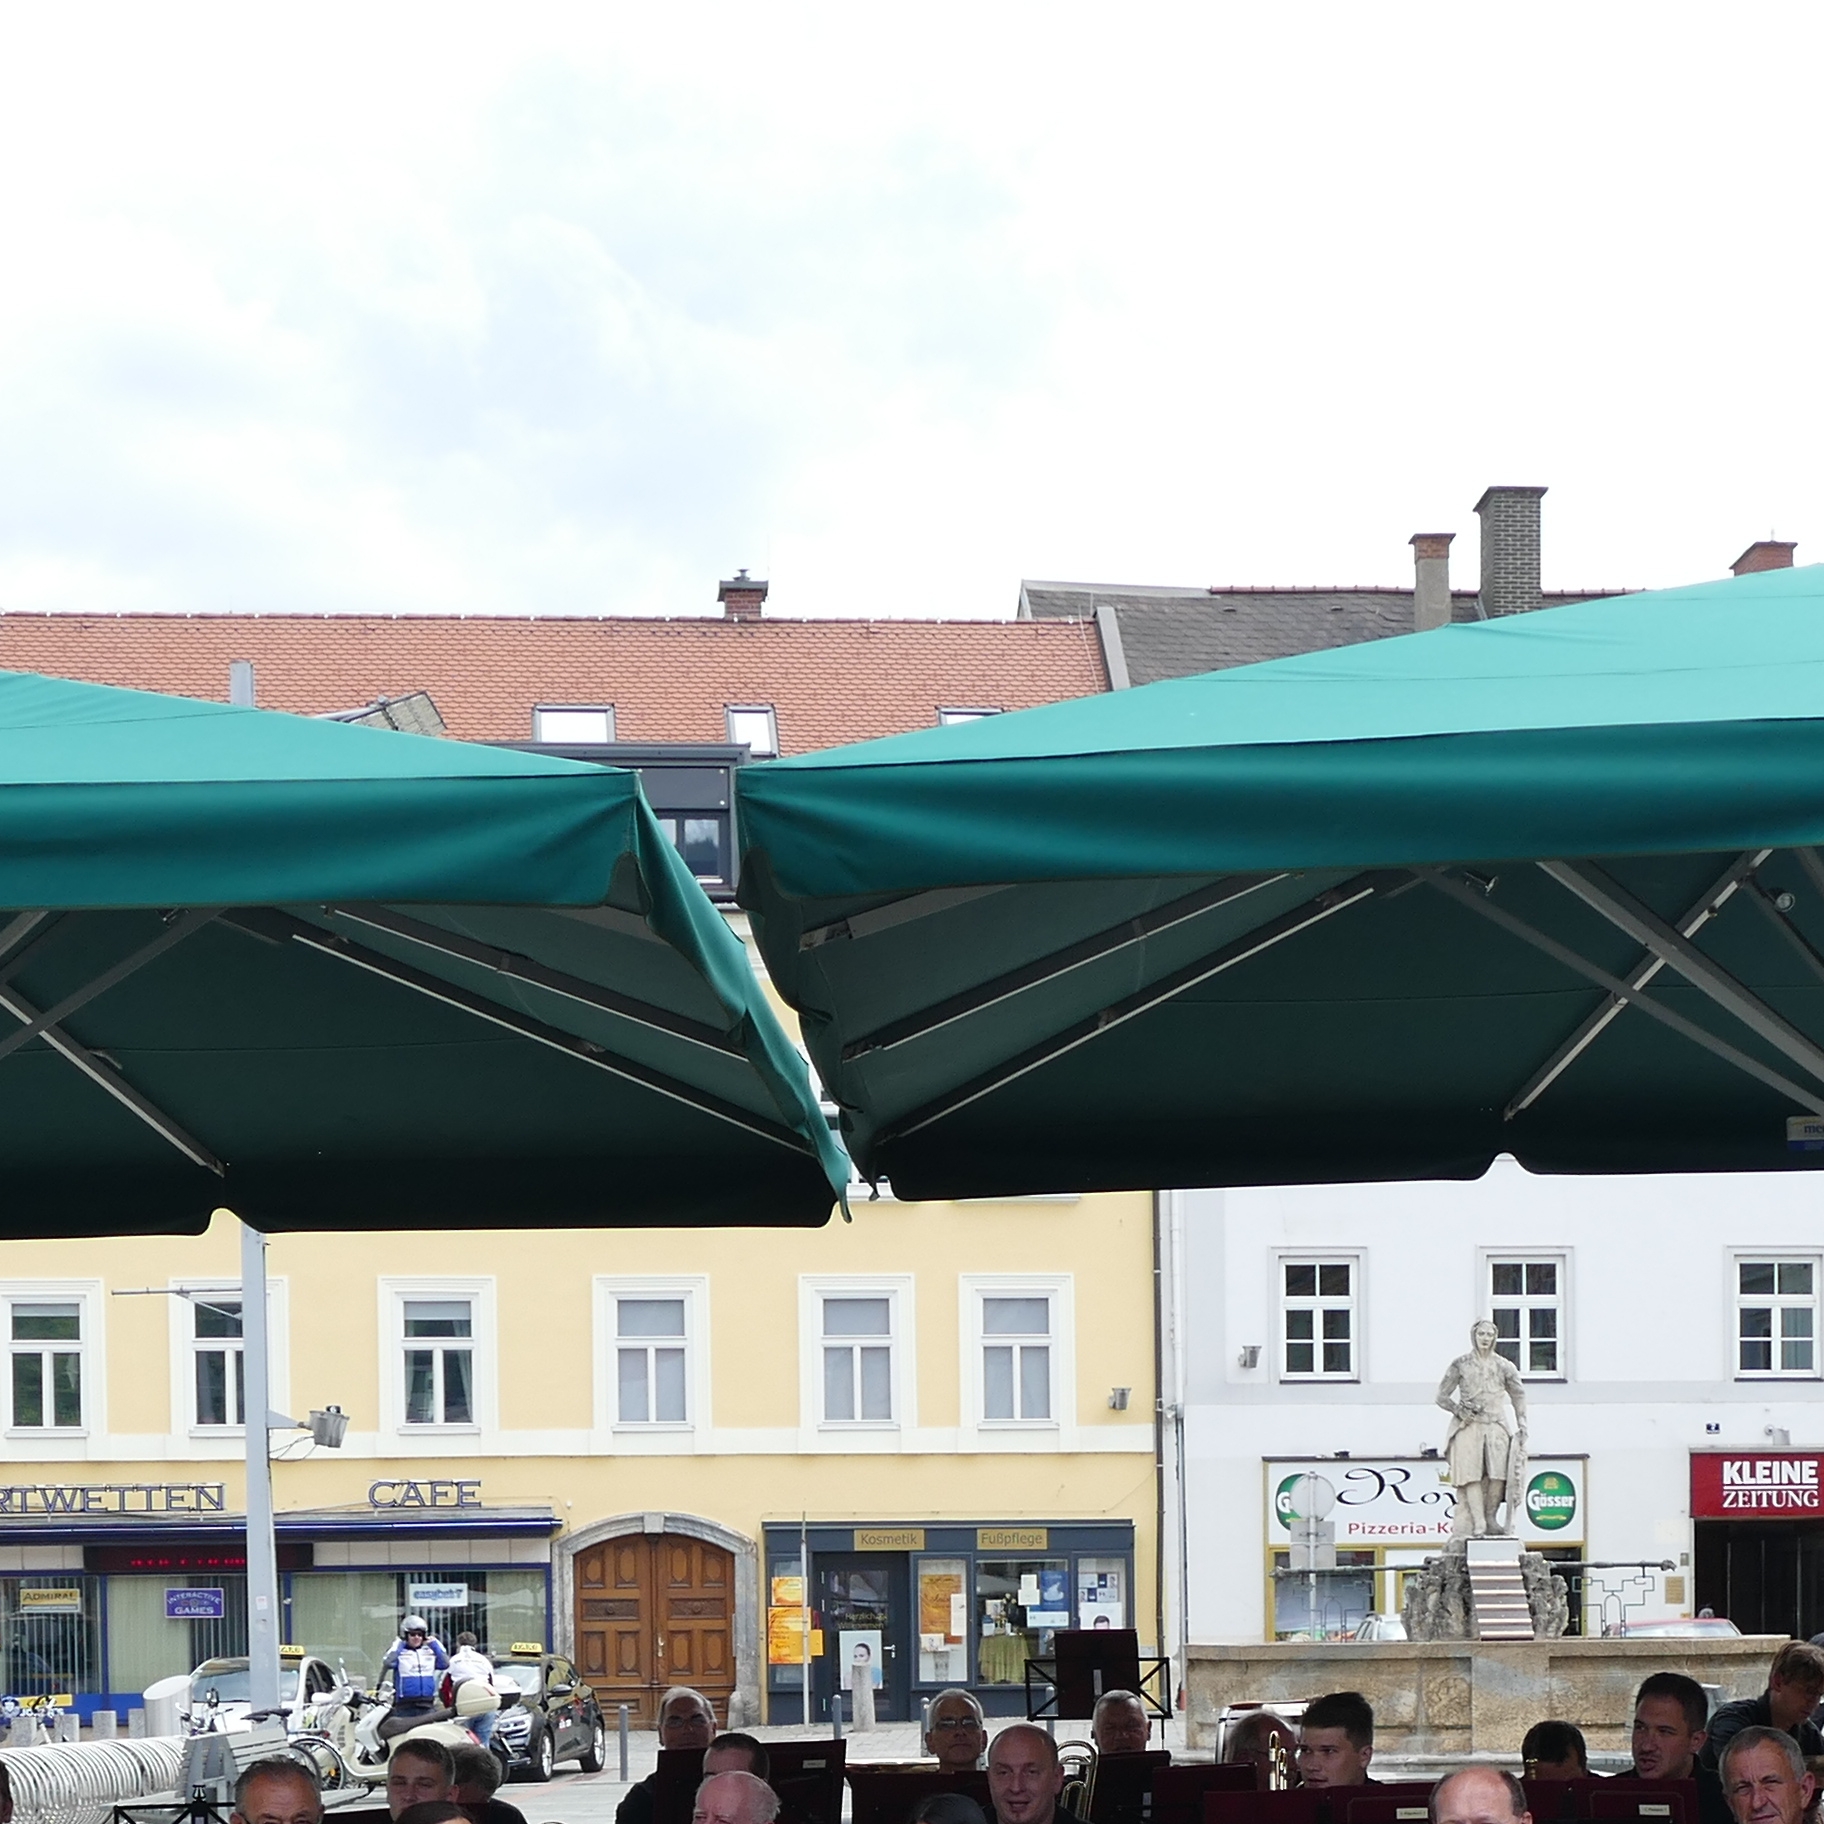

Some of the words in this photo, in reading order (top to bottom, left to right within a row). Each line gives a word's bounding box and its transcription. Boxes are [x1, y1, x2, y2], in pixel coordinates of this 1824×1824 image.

[1722, 1461, 1819, 1485] KLEINE
[368, 1480, 481, 1508] CAFE
[1527, 1489, 1575, 1511] Gösser
[1722, 1490, 1820, 1508] ZEITUNG
[860, 1532, 917, 1546] Kosmetik
[981, 1532, 1043, 1547] Fußpflege
[174, 1606, 215, 1615] GAMES
